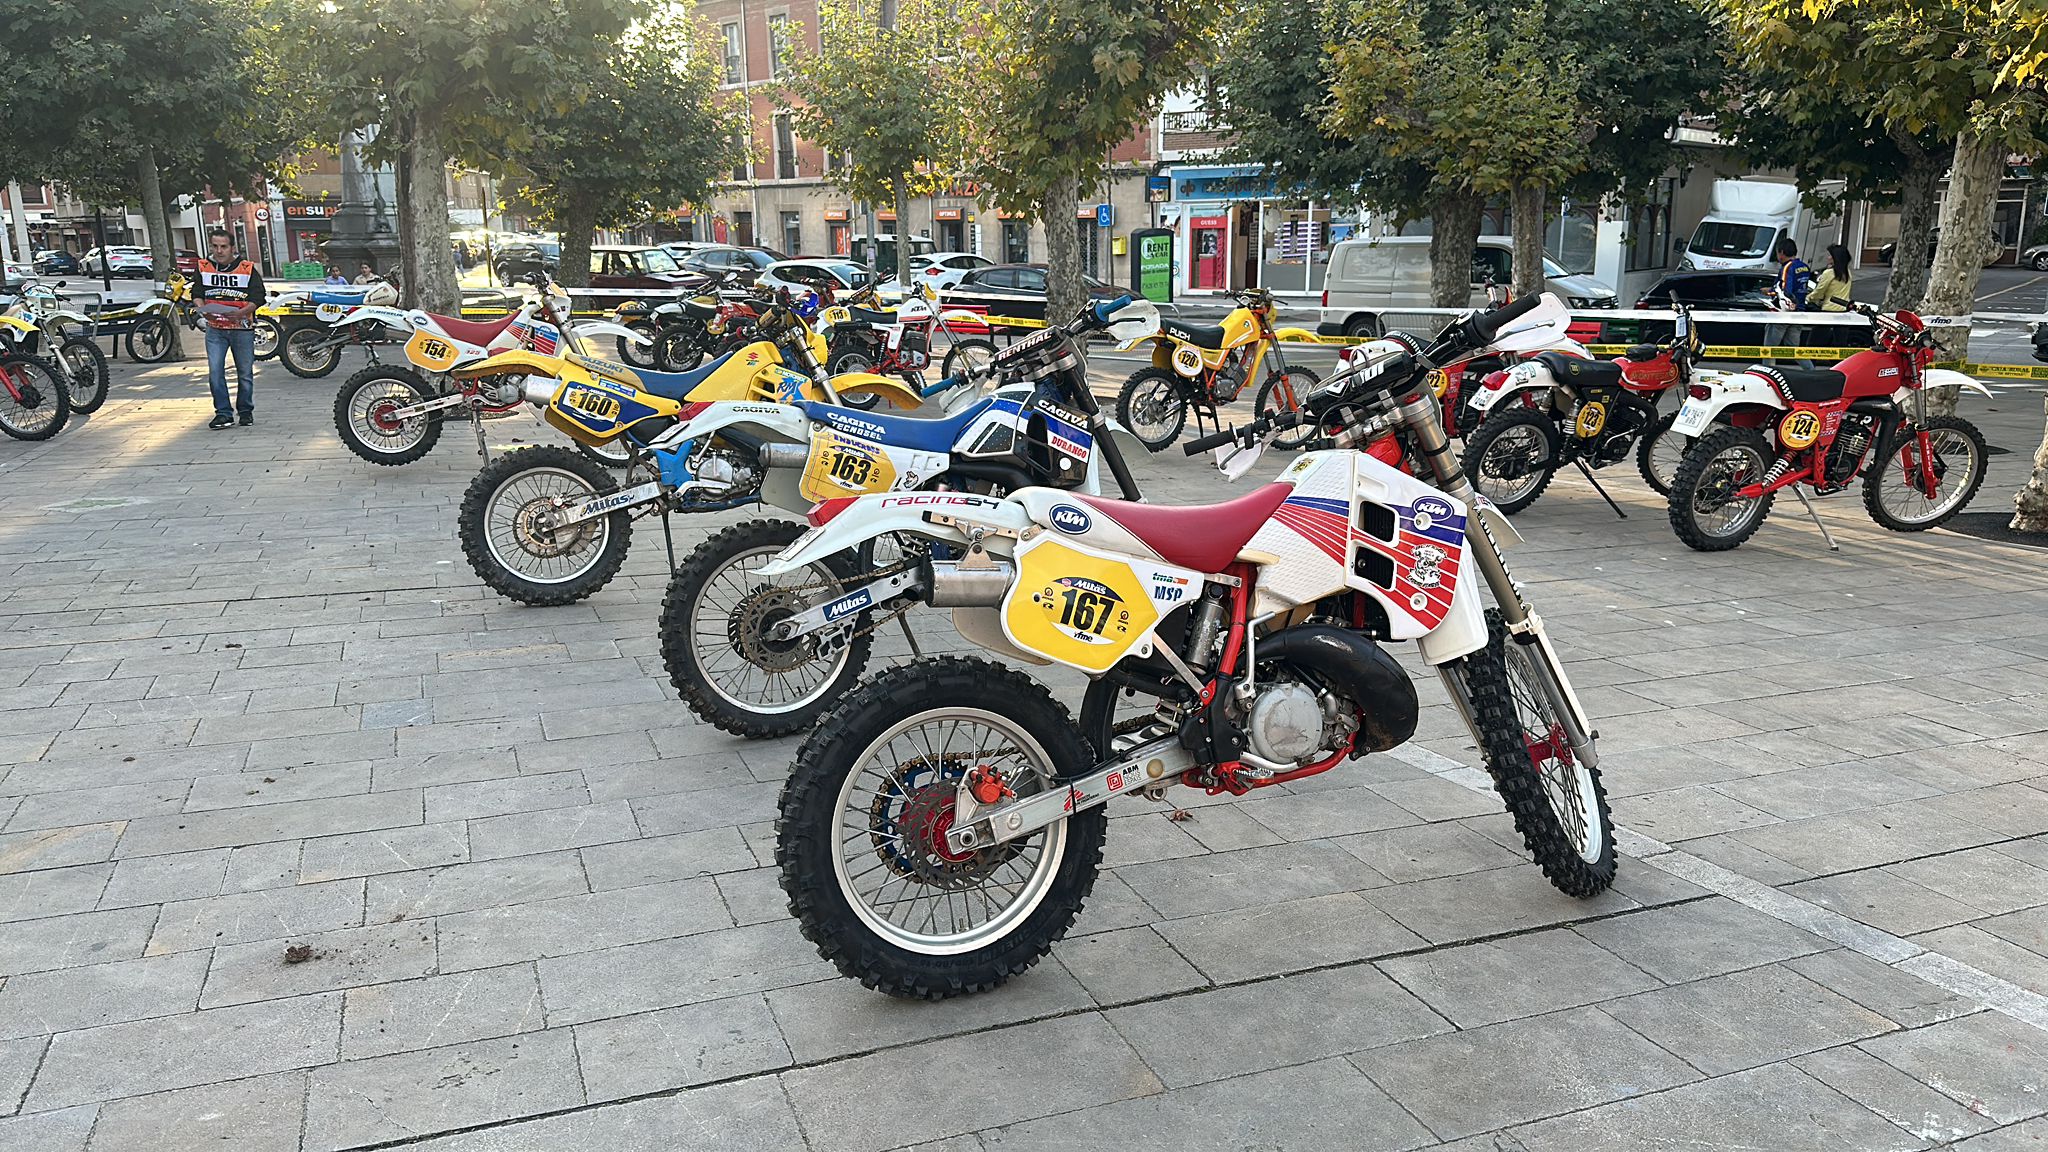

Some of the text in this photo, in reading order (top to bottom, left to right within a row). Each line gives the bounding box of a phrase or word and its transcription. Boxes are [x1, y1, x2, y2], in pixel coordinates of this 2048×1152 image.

[1146, 242, 1169, 252] RENT
[211, 275, 238, 287] ORG
[1170, 326, 1191, 341] PUCH
[423, 342, 446, 359] 154
[998, 331, 1051, 362] RENTHAL
[579, 356, 625, 374] SUZUKI
[1181, 352, 1196, 368] 120
[577, 392, 613, 417] 160
[732, 405, 780, 414] CAGIVA
[826, 412, 886, 435] CAGIVA
[1037, 399, 1089, 430] CAGIVA
[1584, 409, 1599, 427] 123
[831, 421, 882, 441] TECNOSEL
[1792, 418, 1812, 436] 124
[1050, 435, 1088, 459] DURANGO
[829, 451, 872, 486] 163
[580, 494, 631, 517] Mitas
[1416, 502, 1448, 516] KTM
[1053, 509, 1088, 529] KTM
[1073, 579, 1107, 595] Mitas
[1153, 585, 1182, 602] MSP
[828, 594, 868, 618] Mitas
[1060, 588, 1116, 636] 167
[1122, 764, 1140, 776] ABM
